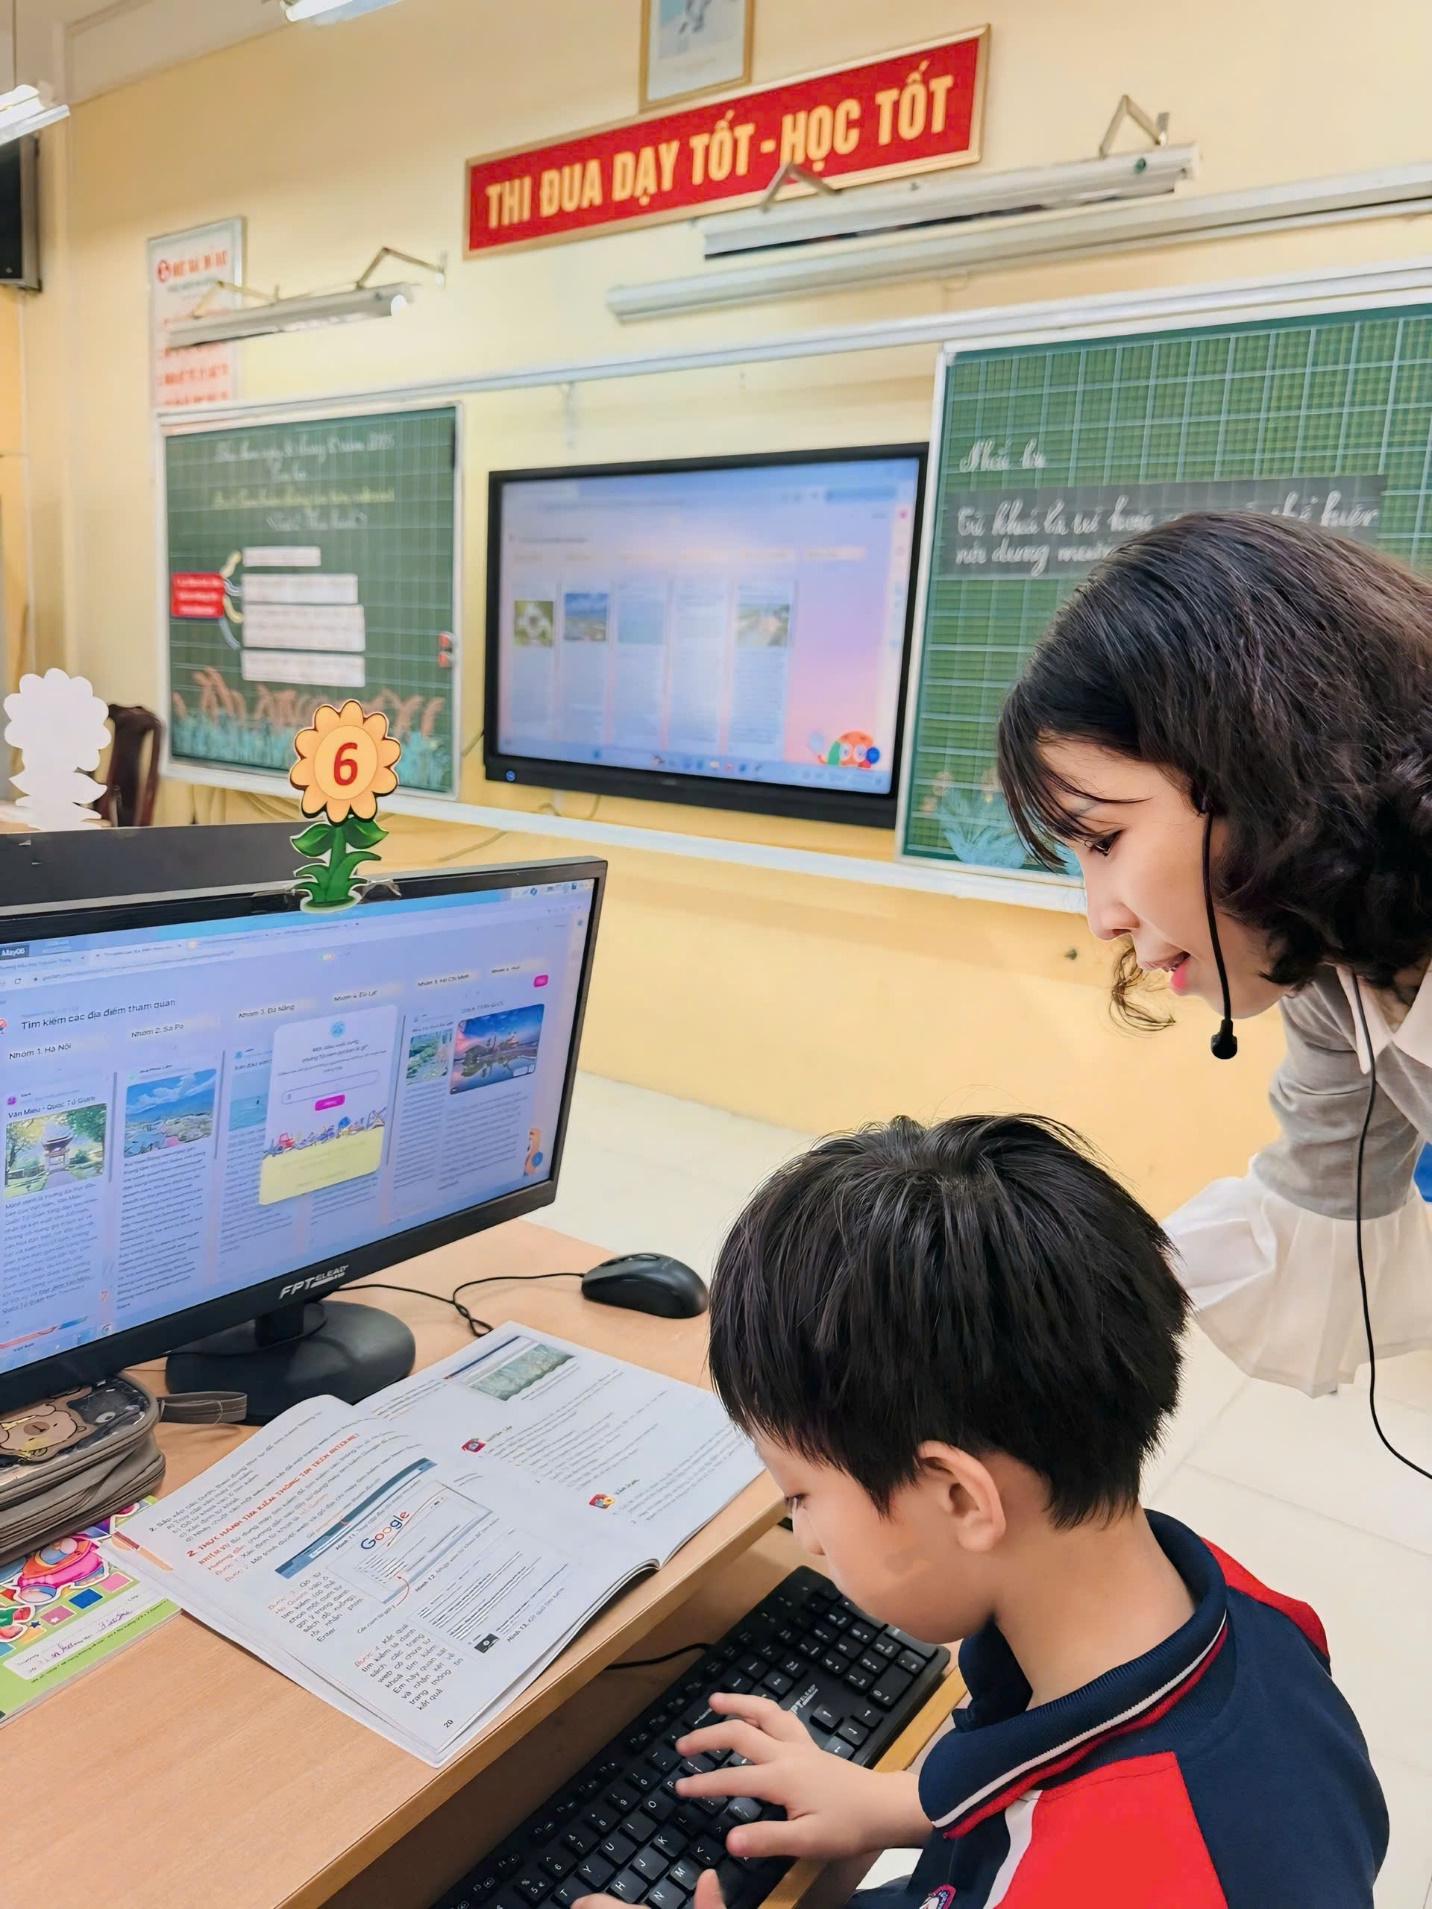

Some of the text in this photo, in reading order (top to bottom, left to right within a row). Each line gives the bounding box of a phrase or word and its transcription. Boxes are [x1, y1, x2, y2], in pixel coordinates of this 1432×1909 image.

[486, 176, 532, 228] THI
[540, 159, 601, 219] ĐUA
[612, 139, 680, 206] DẠY
[690, 109, 755, 185] TỐT
[780, 99, 860, 172] HỌC
[875, 60, 954, 145] TỐT
[333, 742, 358, 786] 6
[128, 1002, 152, 1013] tham
[154, 999, 176, 1009] quan
[9, 1049, 34, 1060] Nhóm
[279, 1277, 315, 1299] FPT
[360, 1511, 410, 1550] Google
[443, 1719, 453, 1728] 20
[648, 1800, 657, 1808] O
[658, 1836, 668, 1845] K
[605, 1843, 615, 1851] U
[638, 1858, 646, 1867] J
[583, 1865, 592, 1873] Y
[674, 1867, 685, 1877] M
[615, 1881, 625, 1891] H
[559, 1888, 568, 1897] T
[654, 1890, 665, 1901] N
